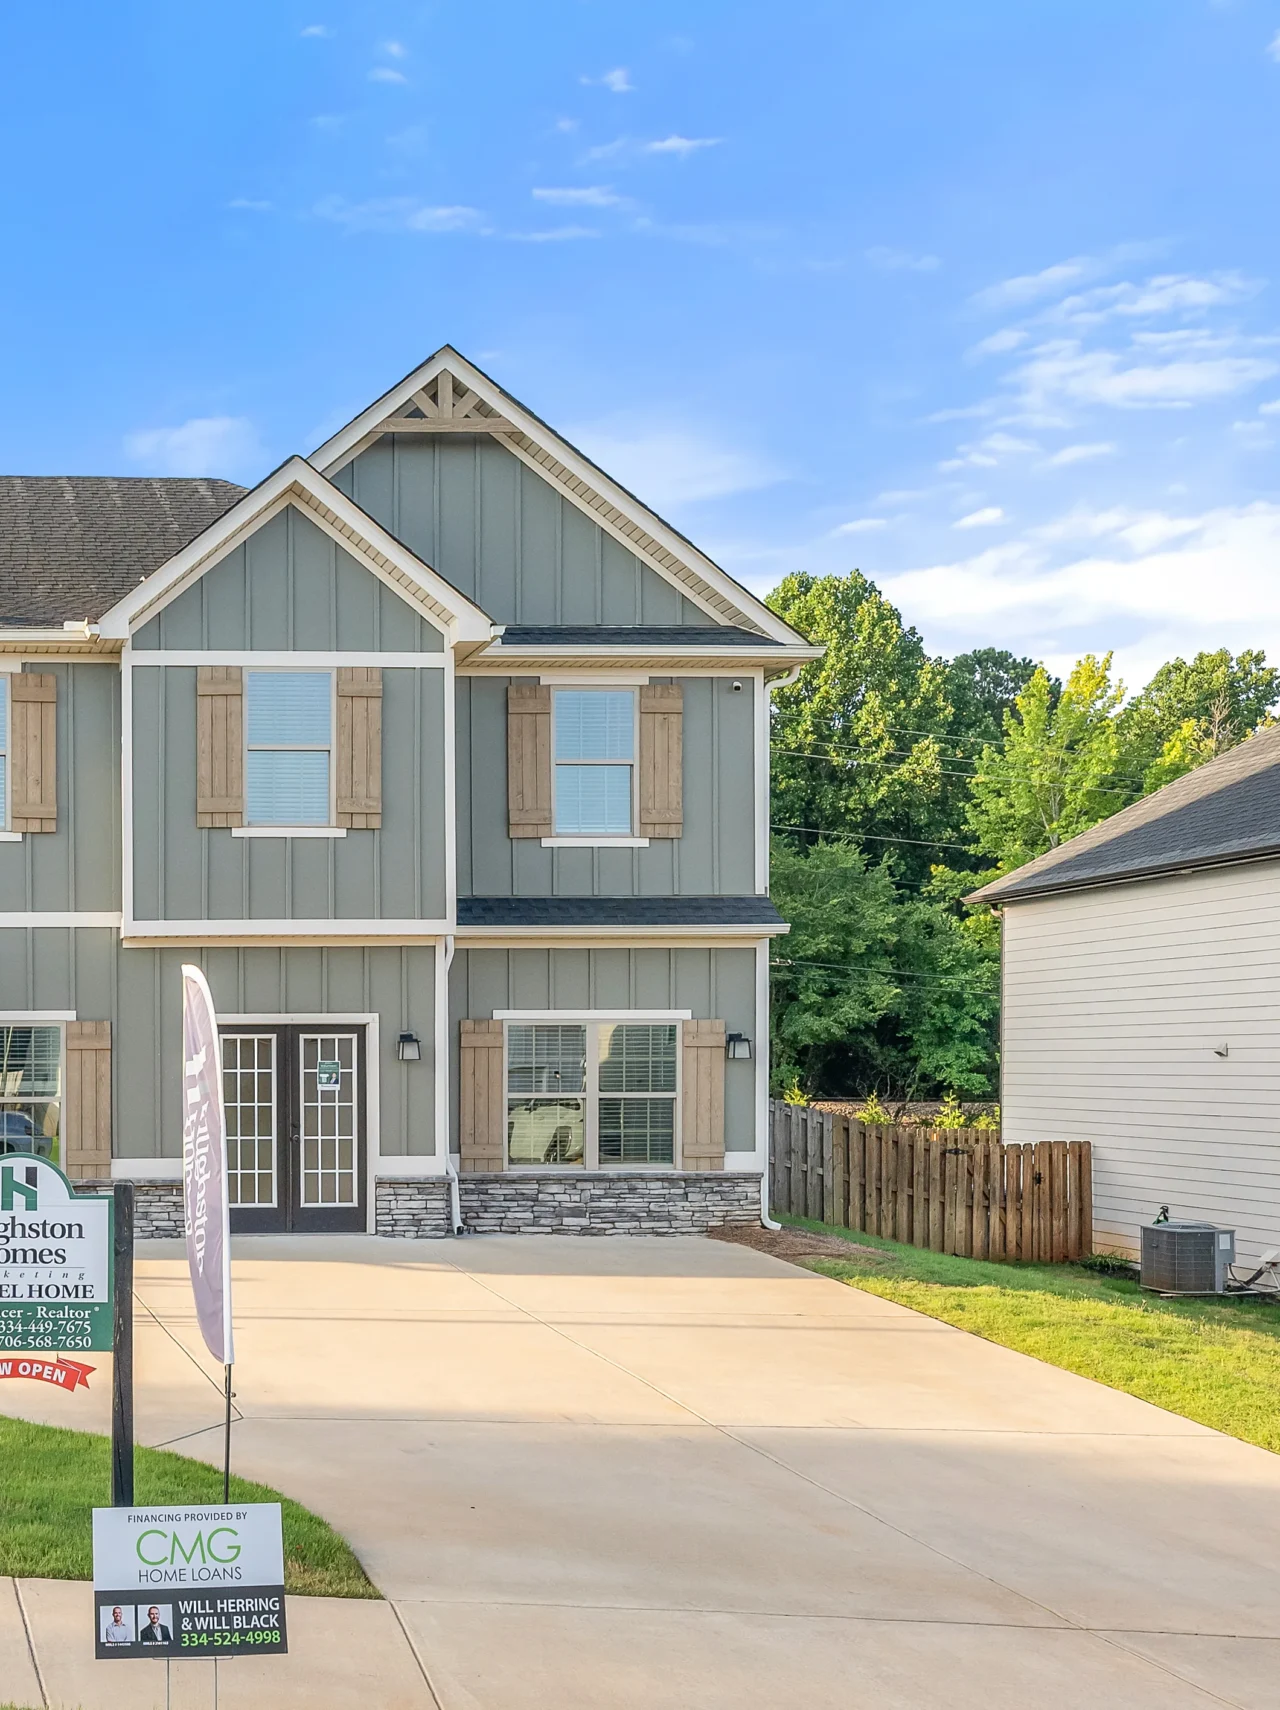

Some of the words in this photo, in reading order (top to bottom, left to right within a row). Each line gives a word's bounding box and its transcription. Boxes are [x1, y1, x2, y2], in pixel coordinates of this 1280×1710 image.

[1, 1166, 38, 1211] H
[27, 1284, 95, 1299] HOME
[18, 1362, 67, 1384] OPEN
[127, 1513, 182, 1523] FINANCING
[184, 1512, 233, 1522] PROVIDED
[236, 1511, 248, 1520] BY
[136, 1527, 242, 1566] CMG
[138, 1568, 187, 1583] HOME
[191, 1566, 242, 1582] LOANS
[178, 1600, 214, 1614] WILL
[216, 1597, 280, 1613] HERRING
[181, 1617, 193, 1631] &
[194, 1615, 233, 1630] WILL
[233, 1613, 279, 1629] BLACK
[180, 1630, 281, 1647] 334-524-4998
